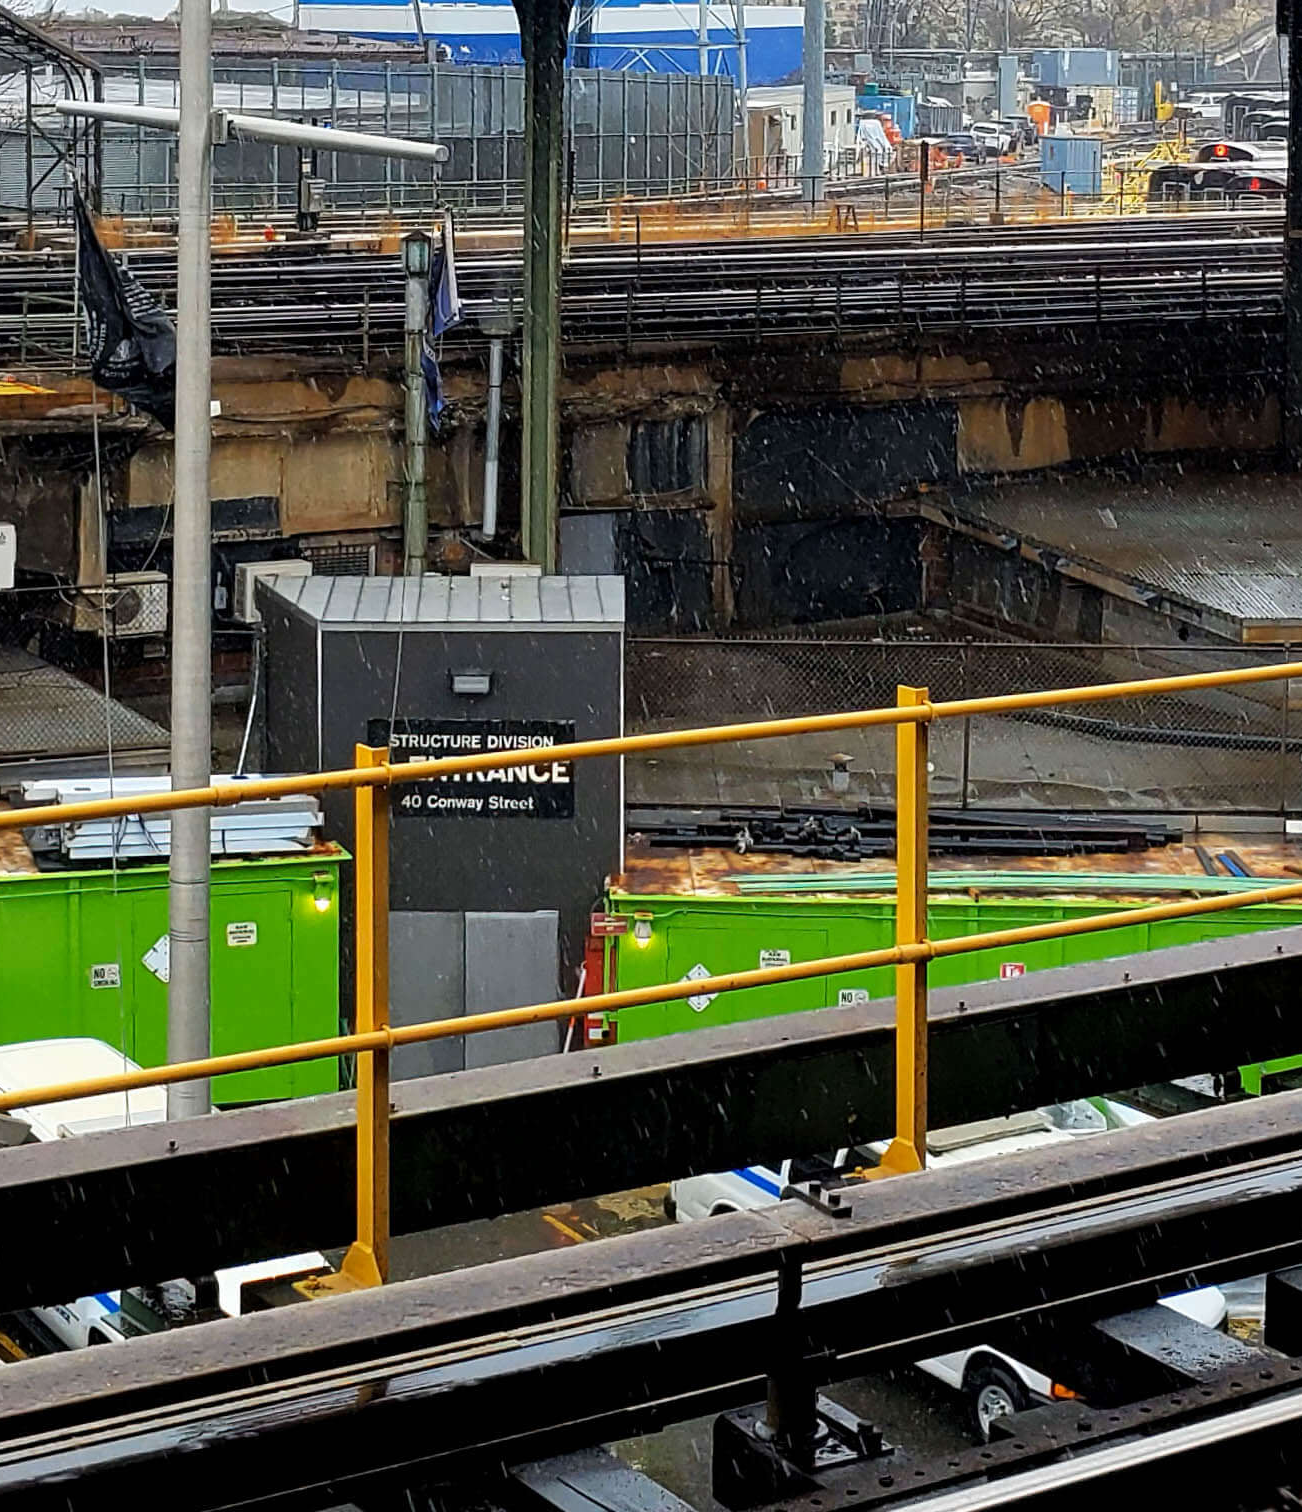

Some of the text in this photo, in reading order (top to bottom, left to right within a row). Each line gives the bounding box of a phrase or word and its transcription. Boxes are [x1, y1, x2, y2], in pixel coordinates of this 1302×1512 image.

[389, 733, 554, 749] STRUCTURE DIVISION
[400, 794, 534, 812] 40 Conway Street
[93, 967, 105, 980] NO
[841, 992, 853, 1004] NO
